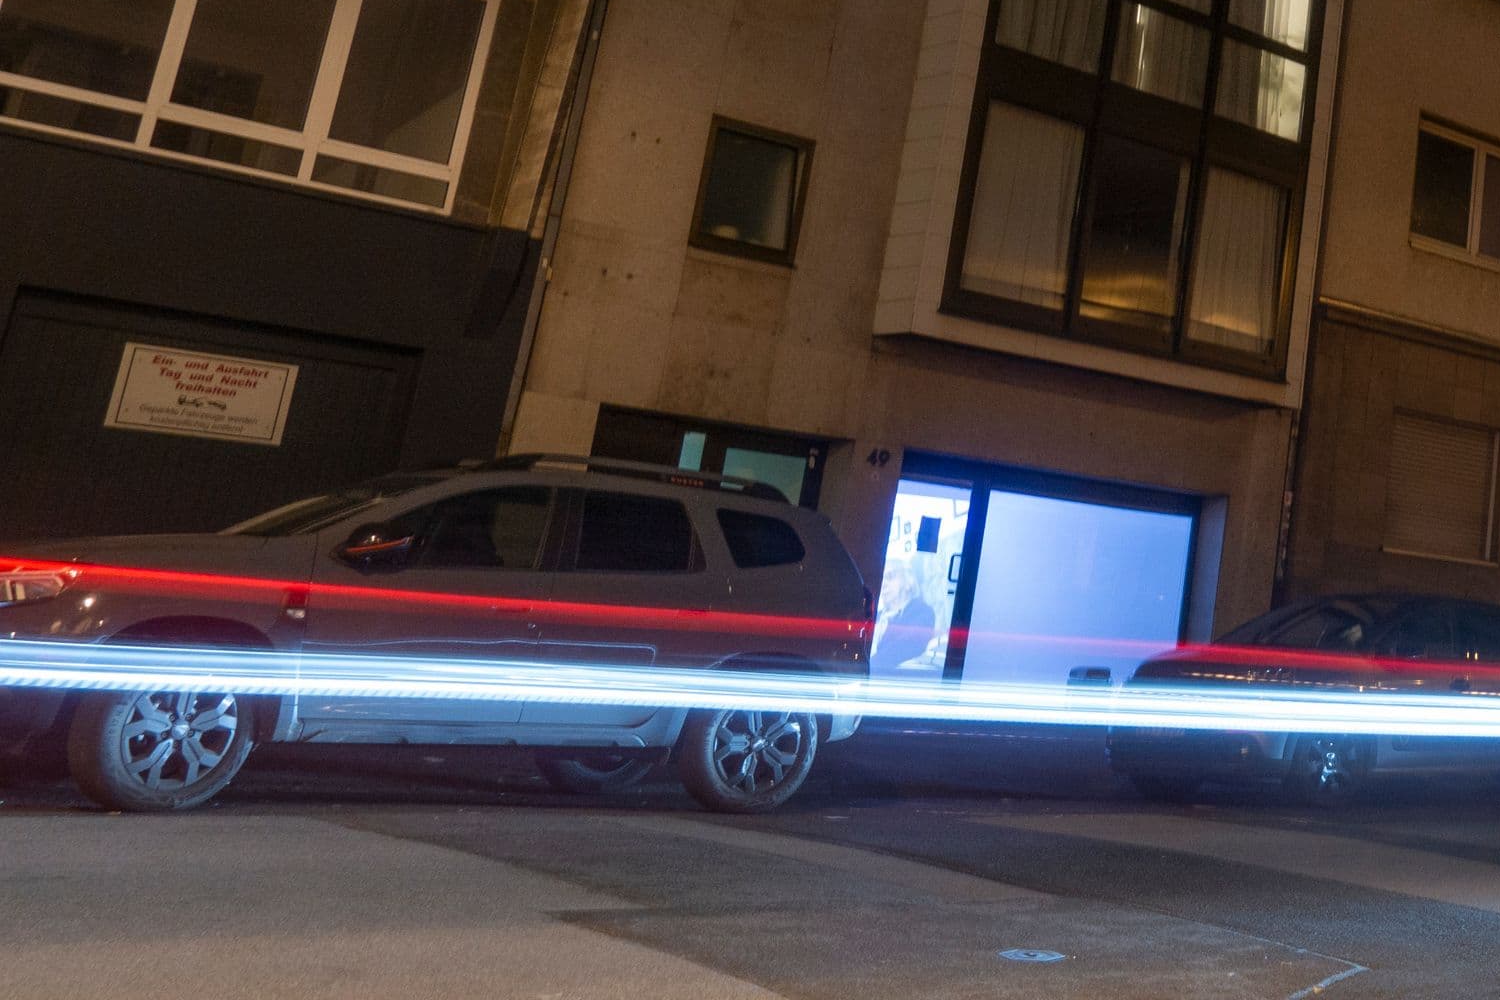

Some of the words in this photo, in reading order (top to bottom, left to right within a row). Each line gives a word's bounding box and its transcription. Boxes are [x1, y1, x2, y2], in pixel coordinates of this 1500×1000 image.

[159, 367, 182, 379] Tag
[189, 373, 213, 382] und
[220, 376, 258, 389] Nacht
[184, 361, 209, 370] und
[215, 364, 270, 379] Ausfahrt
[175, 382, 237, 397] freihalten
[866, 448, 890, 466] 49
